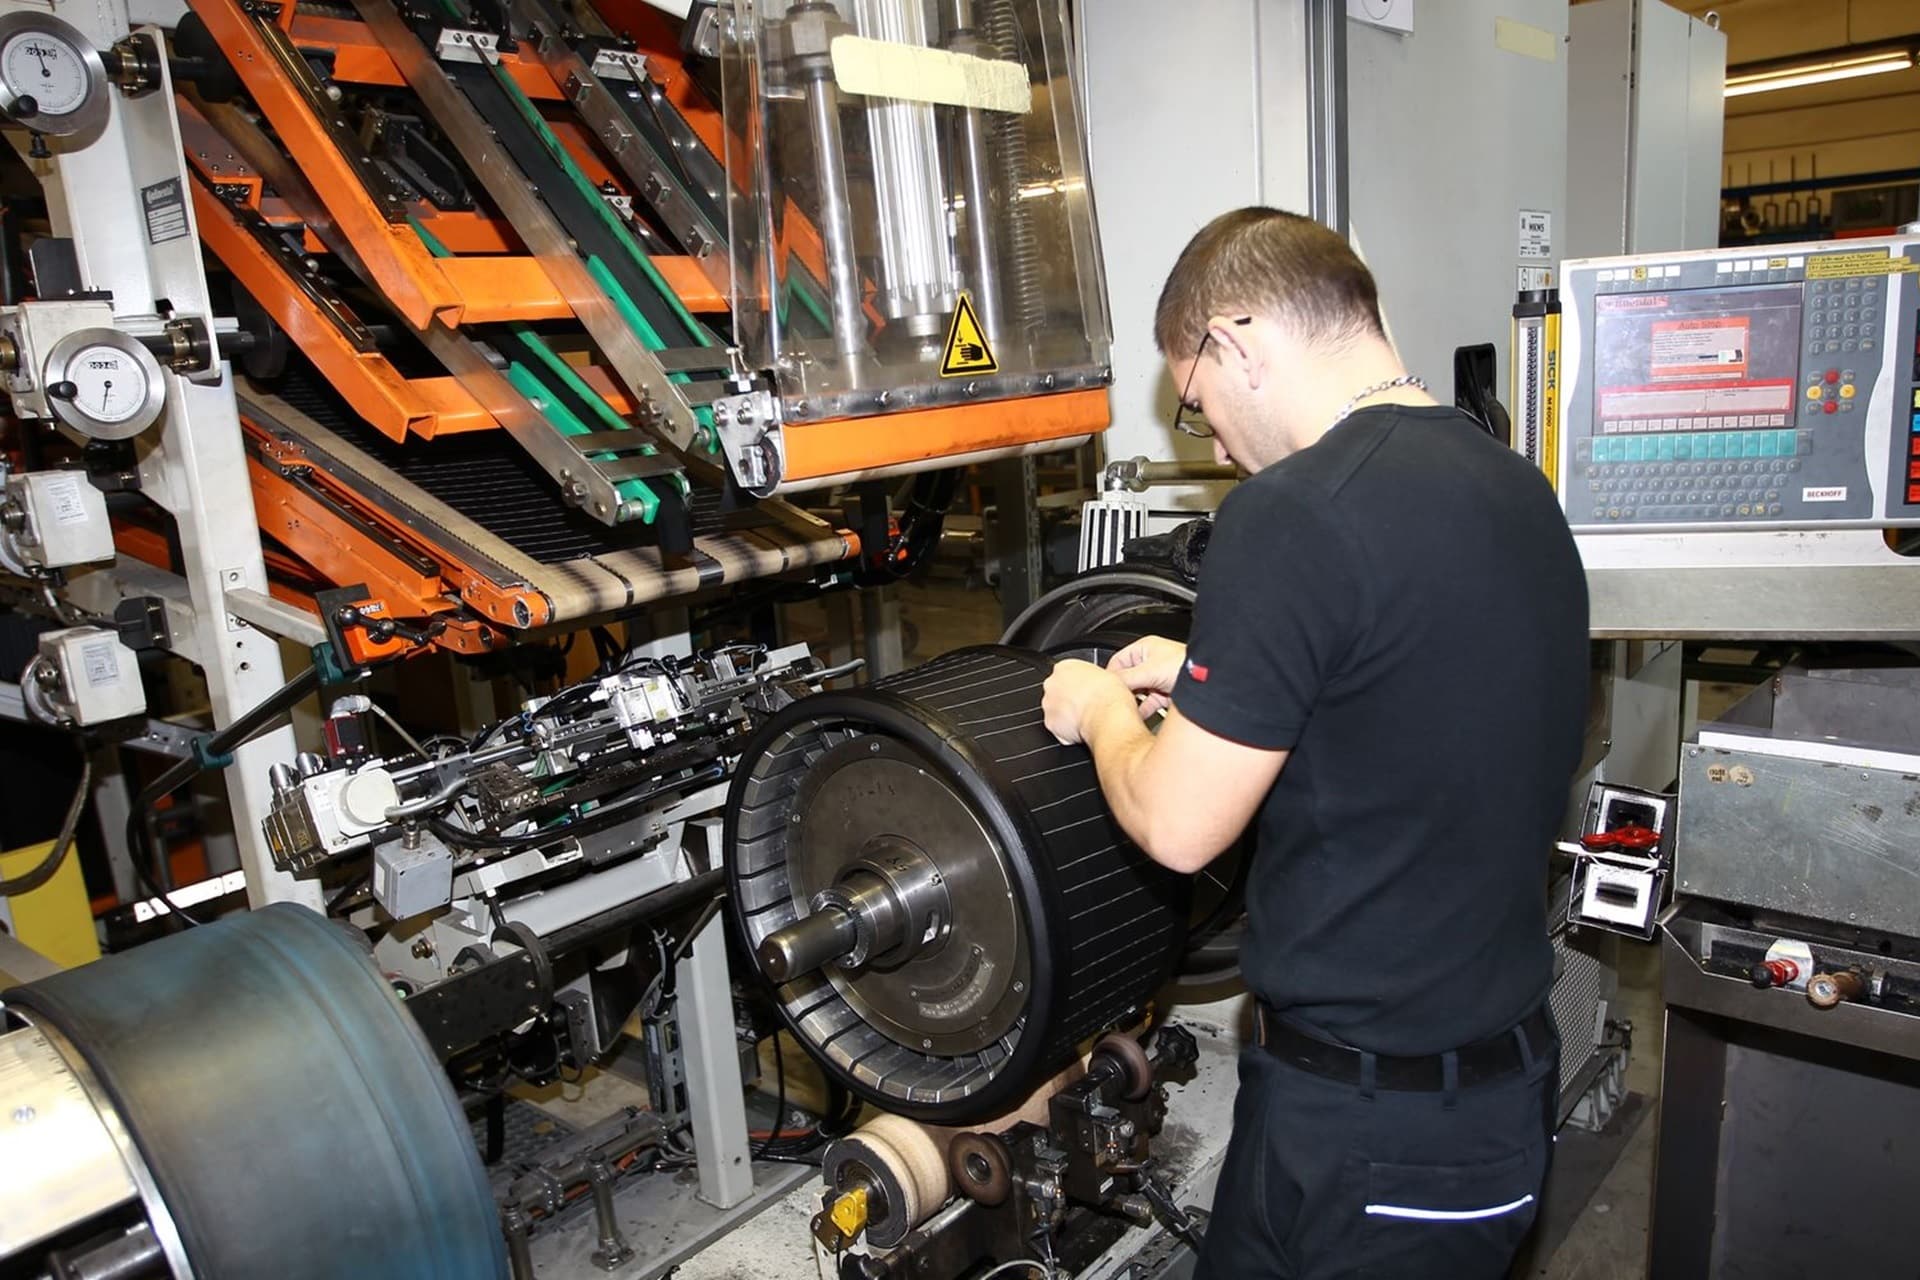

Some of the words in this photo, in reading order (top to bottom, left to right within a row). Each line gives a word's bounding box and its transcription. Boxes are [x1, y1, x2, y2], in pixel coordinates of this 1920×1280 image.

[1600, 297, 1657, 309] Ctinental
[1548, 350, 1556, 390] SICK
[1807, 490, 1841, 498] BECKHOFF
